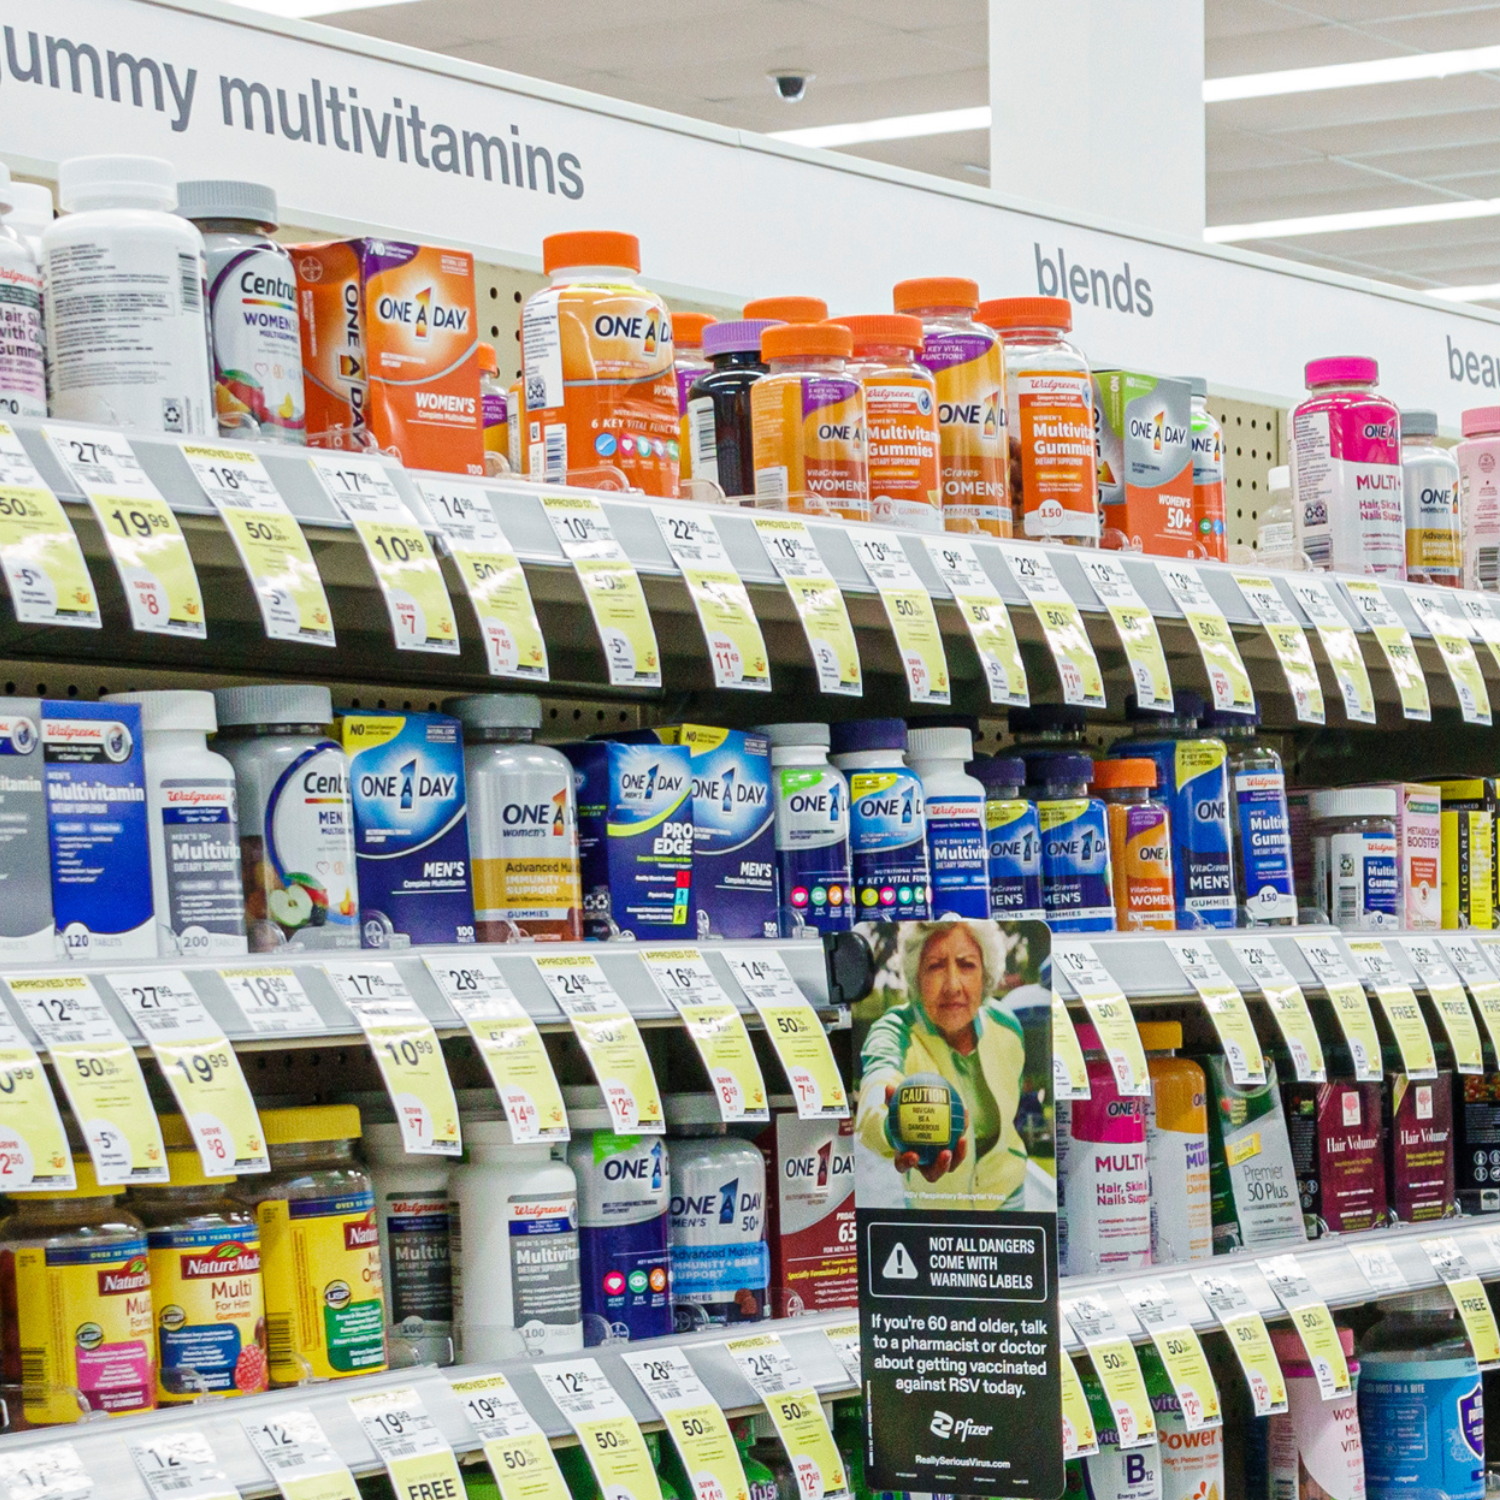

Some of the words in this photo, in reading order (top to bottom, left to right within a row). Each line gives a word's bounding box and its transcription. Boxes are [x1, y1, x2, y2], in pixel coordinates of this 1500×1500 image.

[0, 25, 197, 132] ummy
[219, 74, 585, 201] multivitamins
[1034, 242, 1154, 317] blends
[595, 315, 641, 339] ONE
[1030, 378, 1081, 391] Walgreens
[867, 388, 916, 400] Walgreens
[416, 392, 476, 414] WOMEN'S
[868, 442, 934, 460] Gummies
[807, 479, 866, 493] WOMEN'S
[1420, 487, 1451, 506] ONE
[1041, 506, 1063, 520] 150
[1167, 507, 1192, 529] 50+
[134, 580, 156, 591] save
[47, 724, 102, 739] Walgreens
[48, 782, 145, 803] Multivitamin
[361, 776, 396, 798] ONE
[167, 789, 227, 804] Walgreens
[502, 803, 550, 826] ONE
[860, 800, 899, 817] ONE
[931, 805, 978, 817] Walgreens
[662, 822, 693, 838] PRO
[654, 837, 693, 855] EDGE
[1407, 837, 1440, 850] BOOSTER
[423, 862, 465, 879] MEN'S
[740, 862, 772, 878] MEN'S
[506, 885, 560, 896] SUPPORT
[1189, 875, 1229, 890] MEN'S
[1260, 892, 1277, 903] 150
[456, 926, 474, 938] 100
[67, 934, 89, 949] 120
[183, 935, 209, 949] 200
[1391, 1006, 1417, 1019] FREE
[901, 1086, 948, 1104] CAUTION
[1326, 1137, 1342, 1153] Hair
[1400, 1130, 1419, 1147] Hair
[603, 1158, 648, 1180] ONE
[785, 1156, 815, 1178] ONE
[1095, 1155, 1144, 1173] MULTI
[1242, 1163, 1284, 1182] Premier
[1247, 1185, 1263, 1202] 50
[1264, 1184, 1289, 1200] Plus
[513, 1204, 568, 1217] Walgreens
[930, 1237, 955, 1253] NOT
[956, 1238, 976, 1253] ALL
[978, 1239, 1035, 1254] DANGERS
[930, 1255, 964, 1270] COME
[966, 1256, 998, 1271] WITH
[211, 1279, 252, 1298] Multi
[930, 1272, 987, 1288] WARNING
[989, 1275, 1033, 1290] LABELS
[214, 1301, 227, 1311] For
[230, 1300, 250, 1311] Him
[1461, 1296, 1487, 1314] FREE
[871, 1314, 882, 1328] If
[883, 1316, 926, 1332] you're
[928, 1316, 947, 1331] 60
[950, 1317, 976, 1332] and
[979, 1318, 1018, 1335] older,
[1021, 1320, 1048, 1335] talk
[873, 1335, 888, 1349] to
[890, 1338, 899, 1350] a
[901, 1335, 979, 1355] pharmacist
[981, 1341, 996, 1353] or
[999, 1340, 1047, 1355] doctor
[874, 1355, 915, 1370] about
[916, 1357, 967, 1375] getting
[970, 1358, 1047, 1376] vaccinated
[895, 1376, 946, 1394] against
[948, 1377, 980, 1392] RSV
[982, 1379, 1026, 1397] today.
[954, 1417, 993, 1443] Pfizer
[915, 1455, 1011, 1470] ReallySeriousVirus.com
